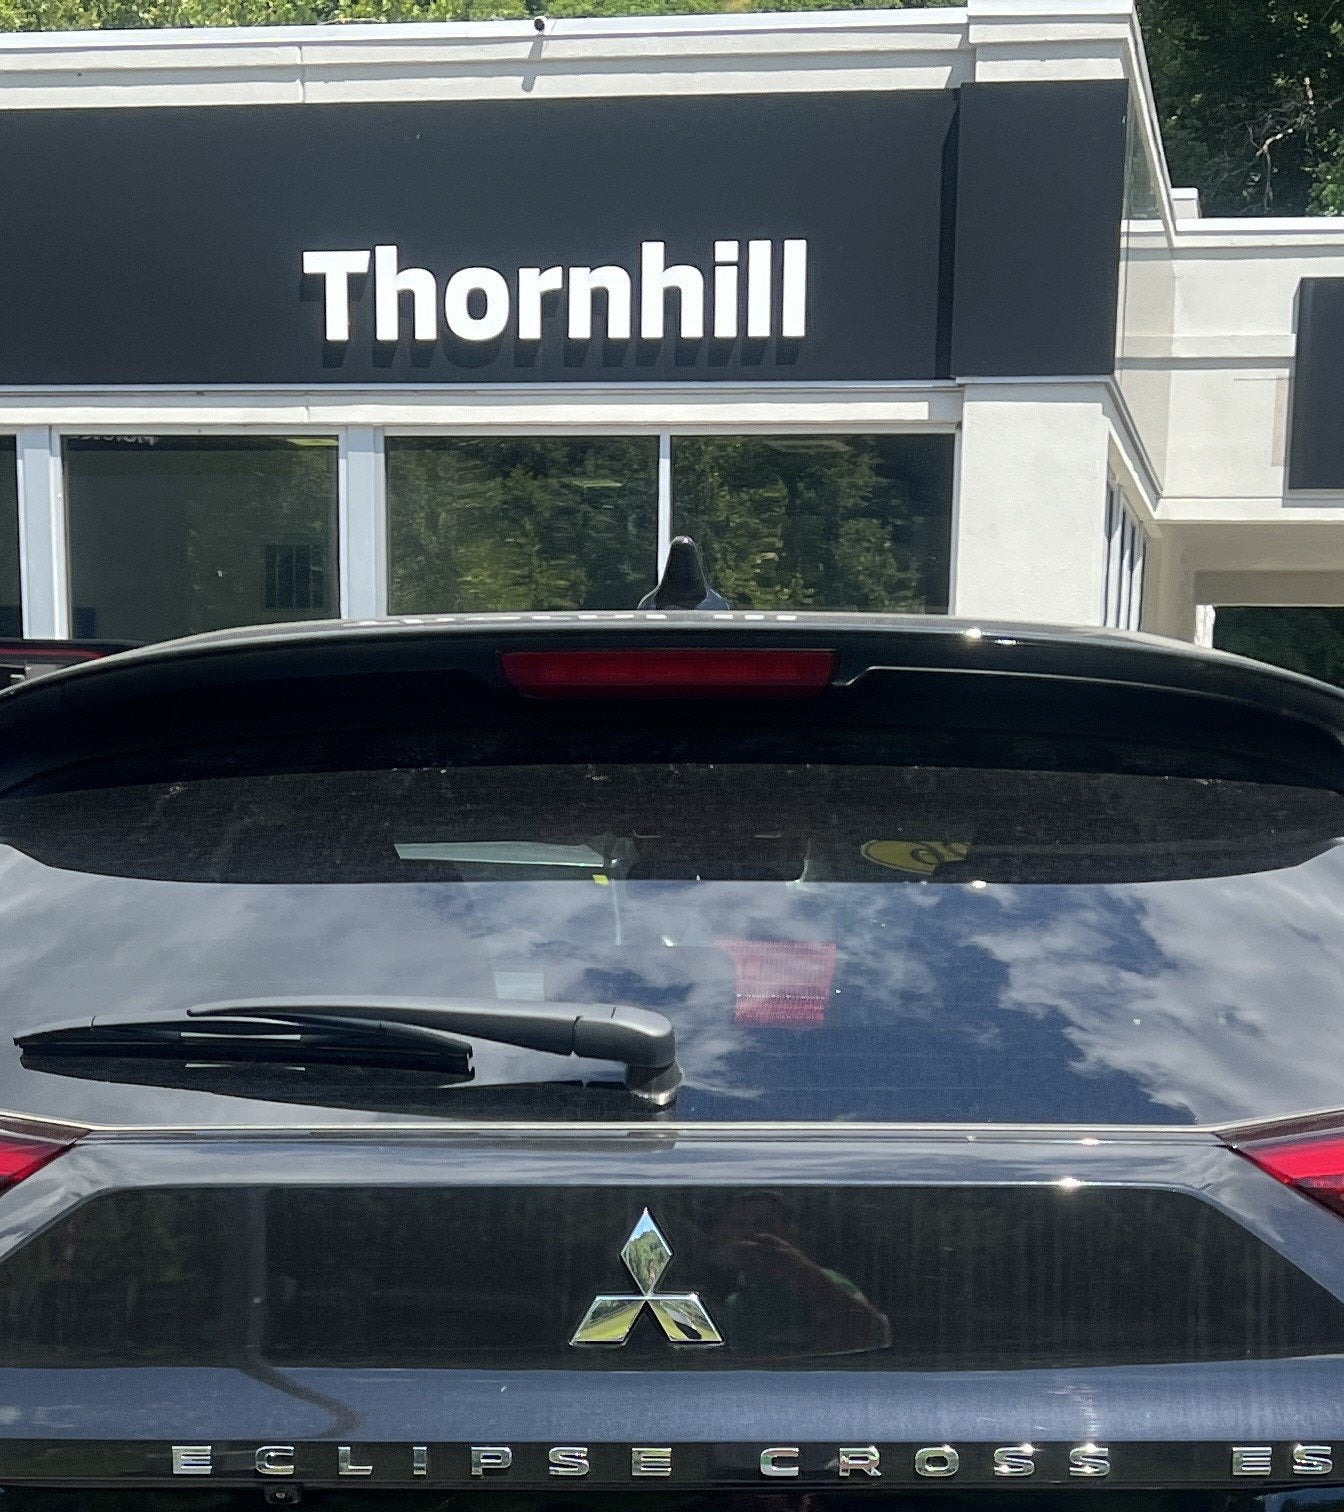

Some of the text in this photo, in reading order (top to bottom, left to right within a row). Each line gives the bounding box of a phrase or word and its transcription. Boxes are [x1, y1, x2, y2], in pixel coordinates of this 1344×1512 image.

[302, 239, 807, 341] Thornhill
[171, 1446, 1334, 1477] ECLIPSE CROSS ES
